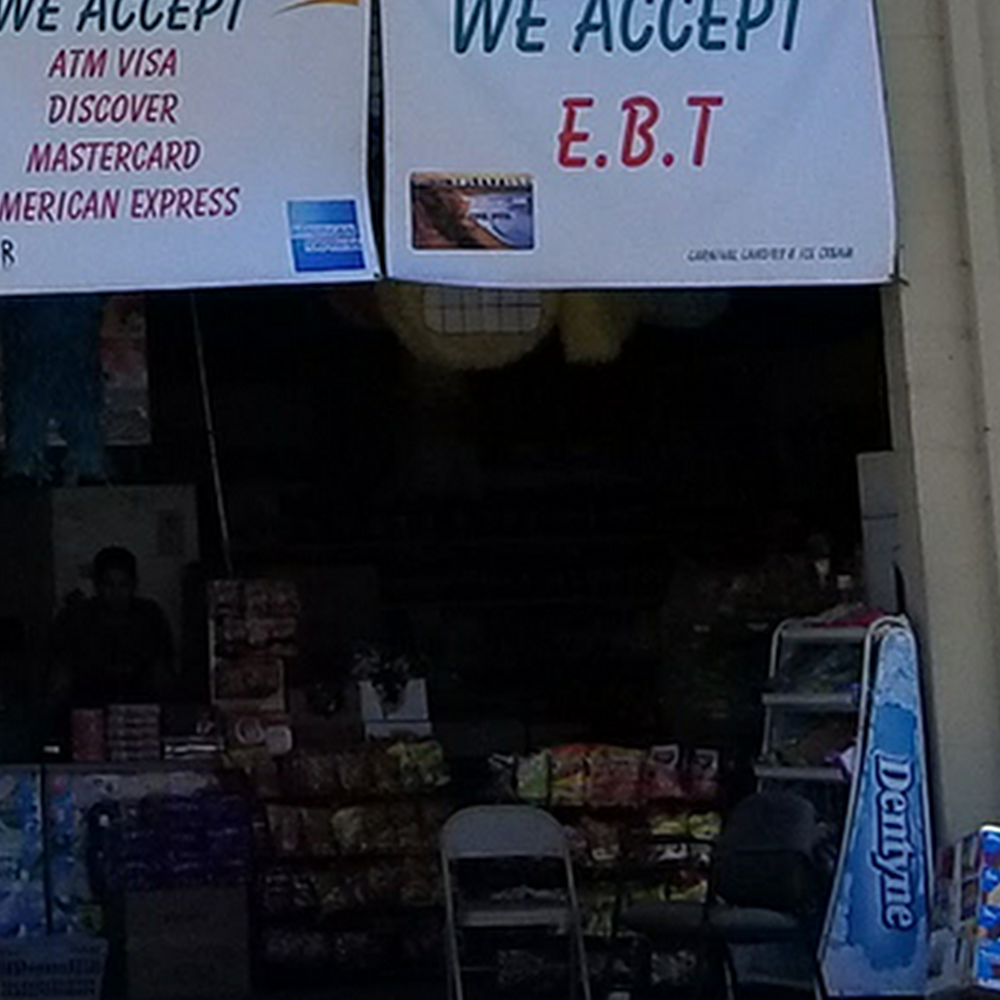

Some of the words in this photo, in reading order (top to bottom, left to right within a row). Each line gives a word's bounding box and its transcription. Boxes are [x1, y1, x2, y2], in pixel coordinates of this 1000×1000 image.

[49, 49, 107, 78] ATM
[117, 47, 178, 78] VISA
[48, 94, 179, 125] DISCOVER
[557, 95, 724, 168] E.B.T
[26, 140, 201, 174] MASTERCARD
[130, 187, 241, 218] EXPRESS
[872, 752, 917, 932] Dentyne
